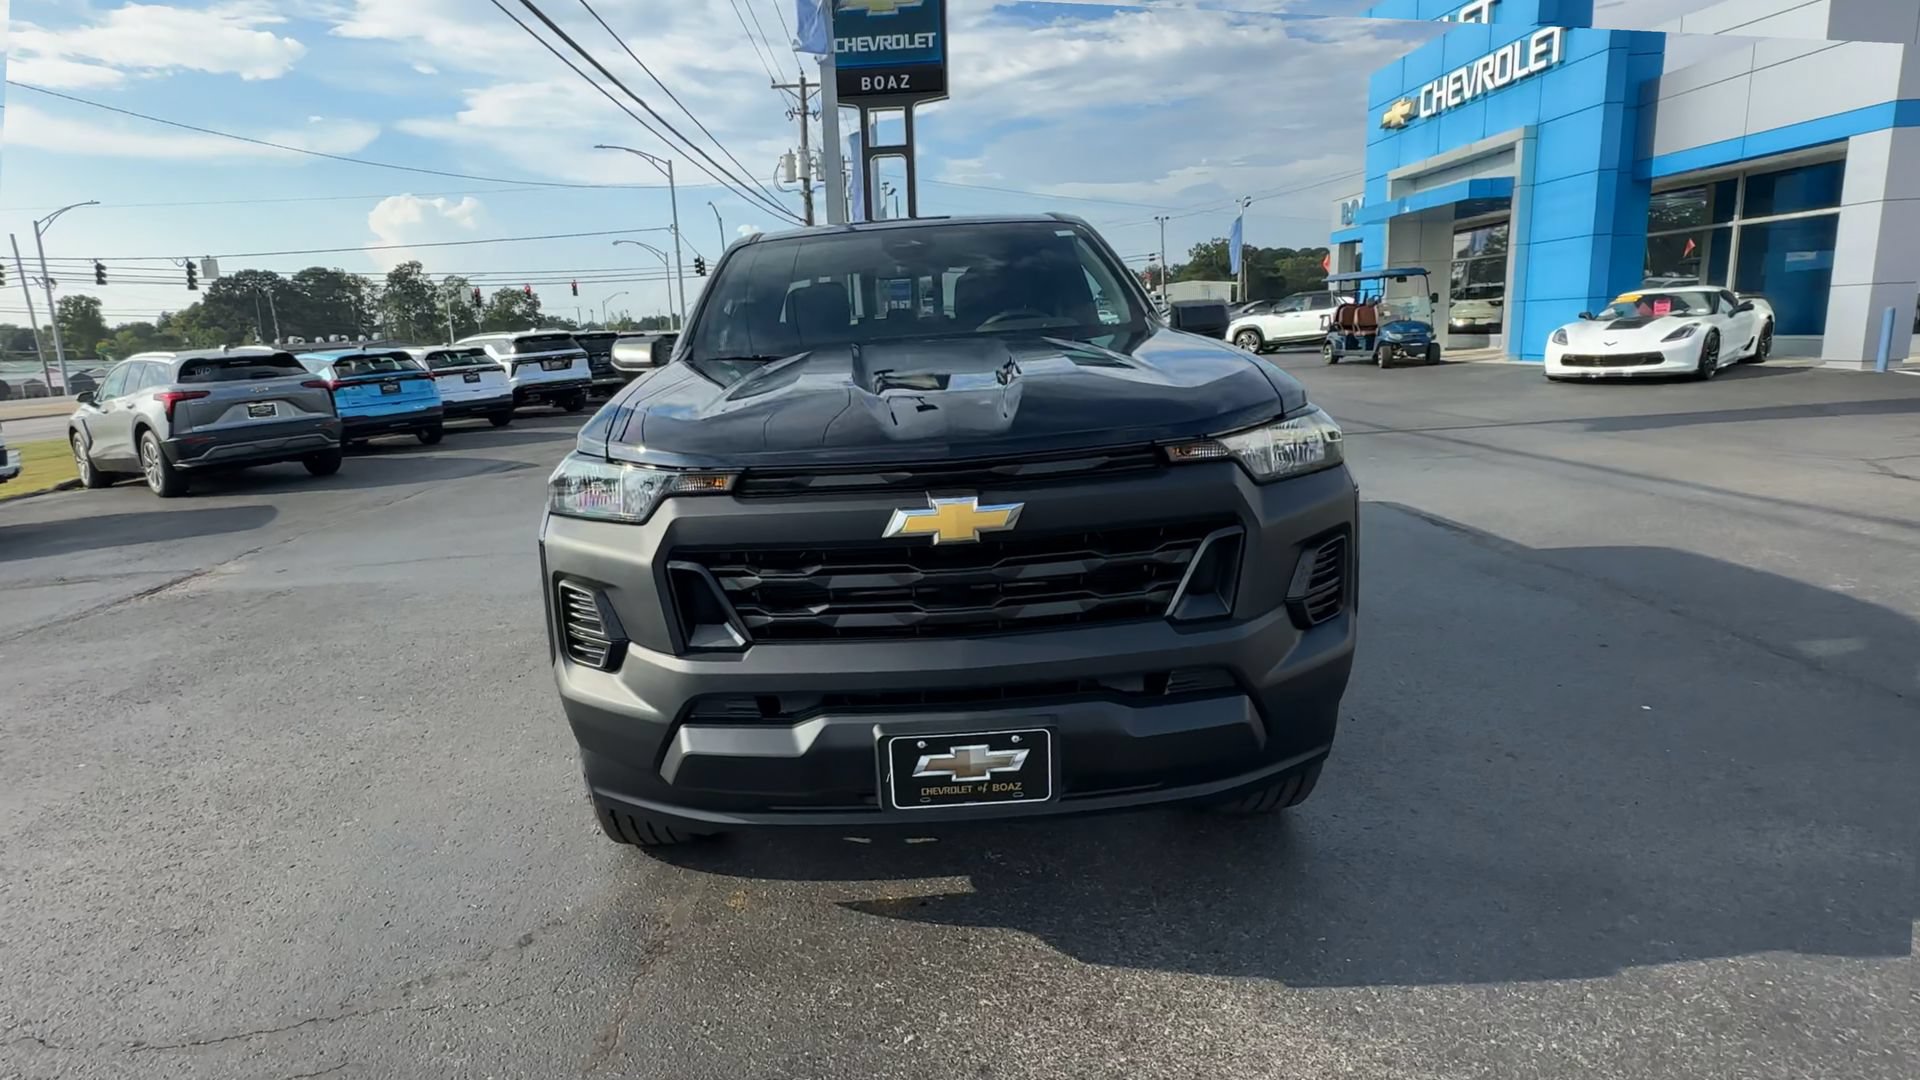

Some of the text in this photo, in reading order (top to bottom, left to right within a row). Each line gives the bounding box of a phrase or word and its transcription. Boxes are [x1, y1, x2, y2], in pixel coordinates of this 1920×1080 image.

[834, 32, 936, 53] CHEVROLET
[1420, 26, 1562, 118] CHEVROLET
[861, 75, 910, 91] BOAZ
[921, 782, 1022, 796] CHEVROLET of BOAZ
